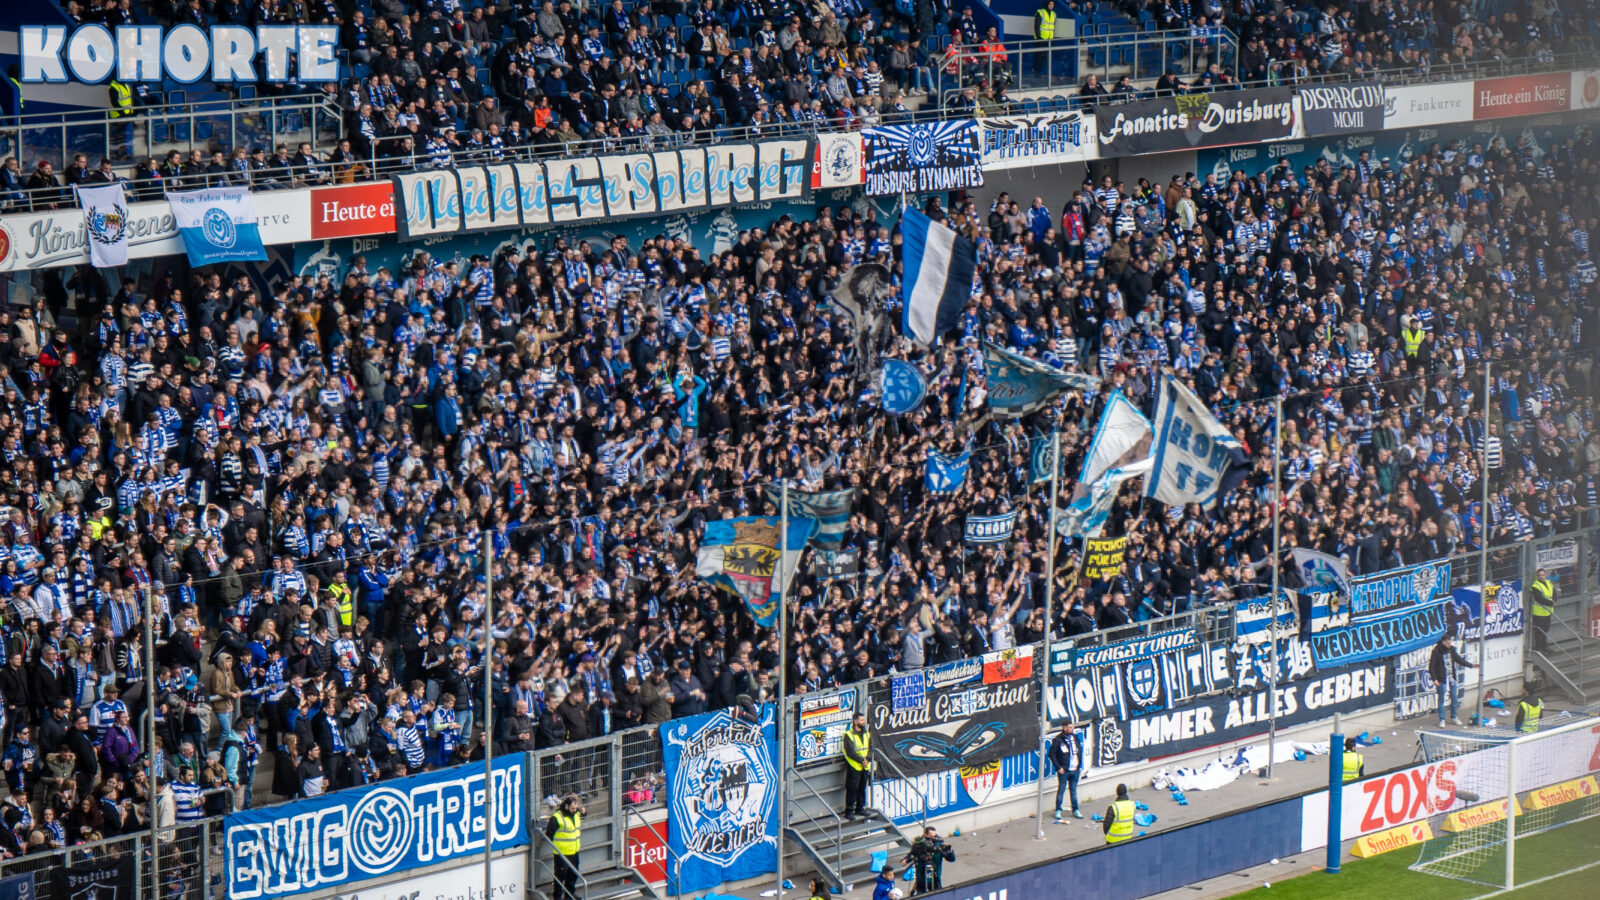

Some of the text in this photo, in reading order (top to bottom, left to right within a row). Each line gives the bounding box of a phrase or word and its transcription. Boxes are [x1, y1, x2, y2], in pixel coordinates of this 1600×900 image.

[1410, 98, 1462, 112] Fankurve
[1480, 84, 1567, 107] Heute ein König
[1199, 99, 1291, 133] Duisburg
[1332, 111, 1364, 128] MCMII
[866, 164, 984, 196] DUISBURG DYNAMITES
[322, 201, 376, 223] Heute
[1312, 608, 1446, 662] WEDAUSTADION
[892, 673, 924, 687] SEKTION
[892, 684, 925, 698] STADION
[875, 698, 930, 730] Proud
[1130, 665, 1386, 749] IMMER ALLES GEBEN!
[1360, 760, 1457, 833] ZOXS
[1539, 785, 1577, 807] Sinalco
[1459, 806, 1499, 830] Sinalco
[227, 764, 521, 900] EWIG TREU
[1368, 830, 1409, 854] Sinalco
